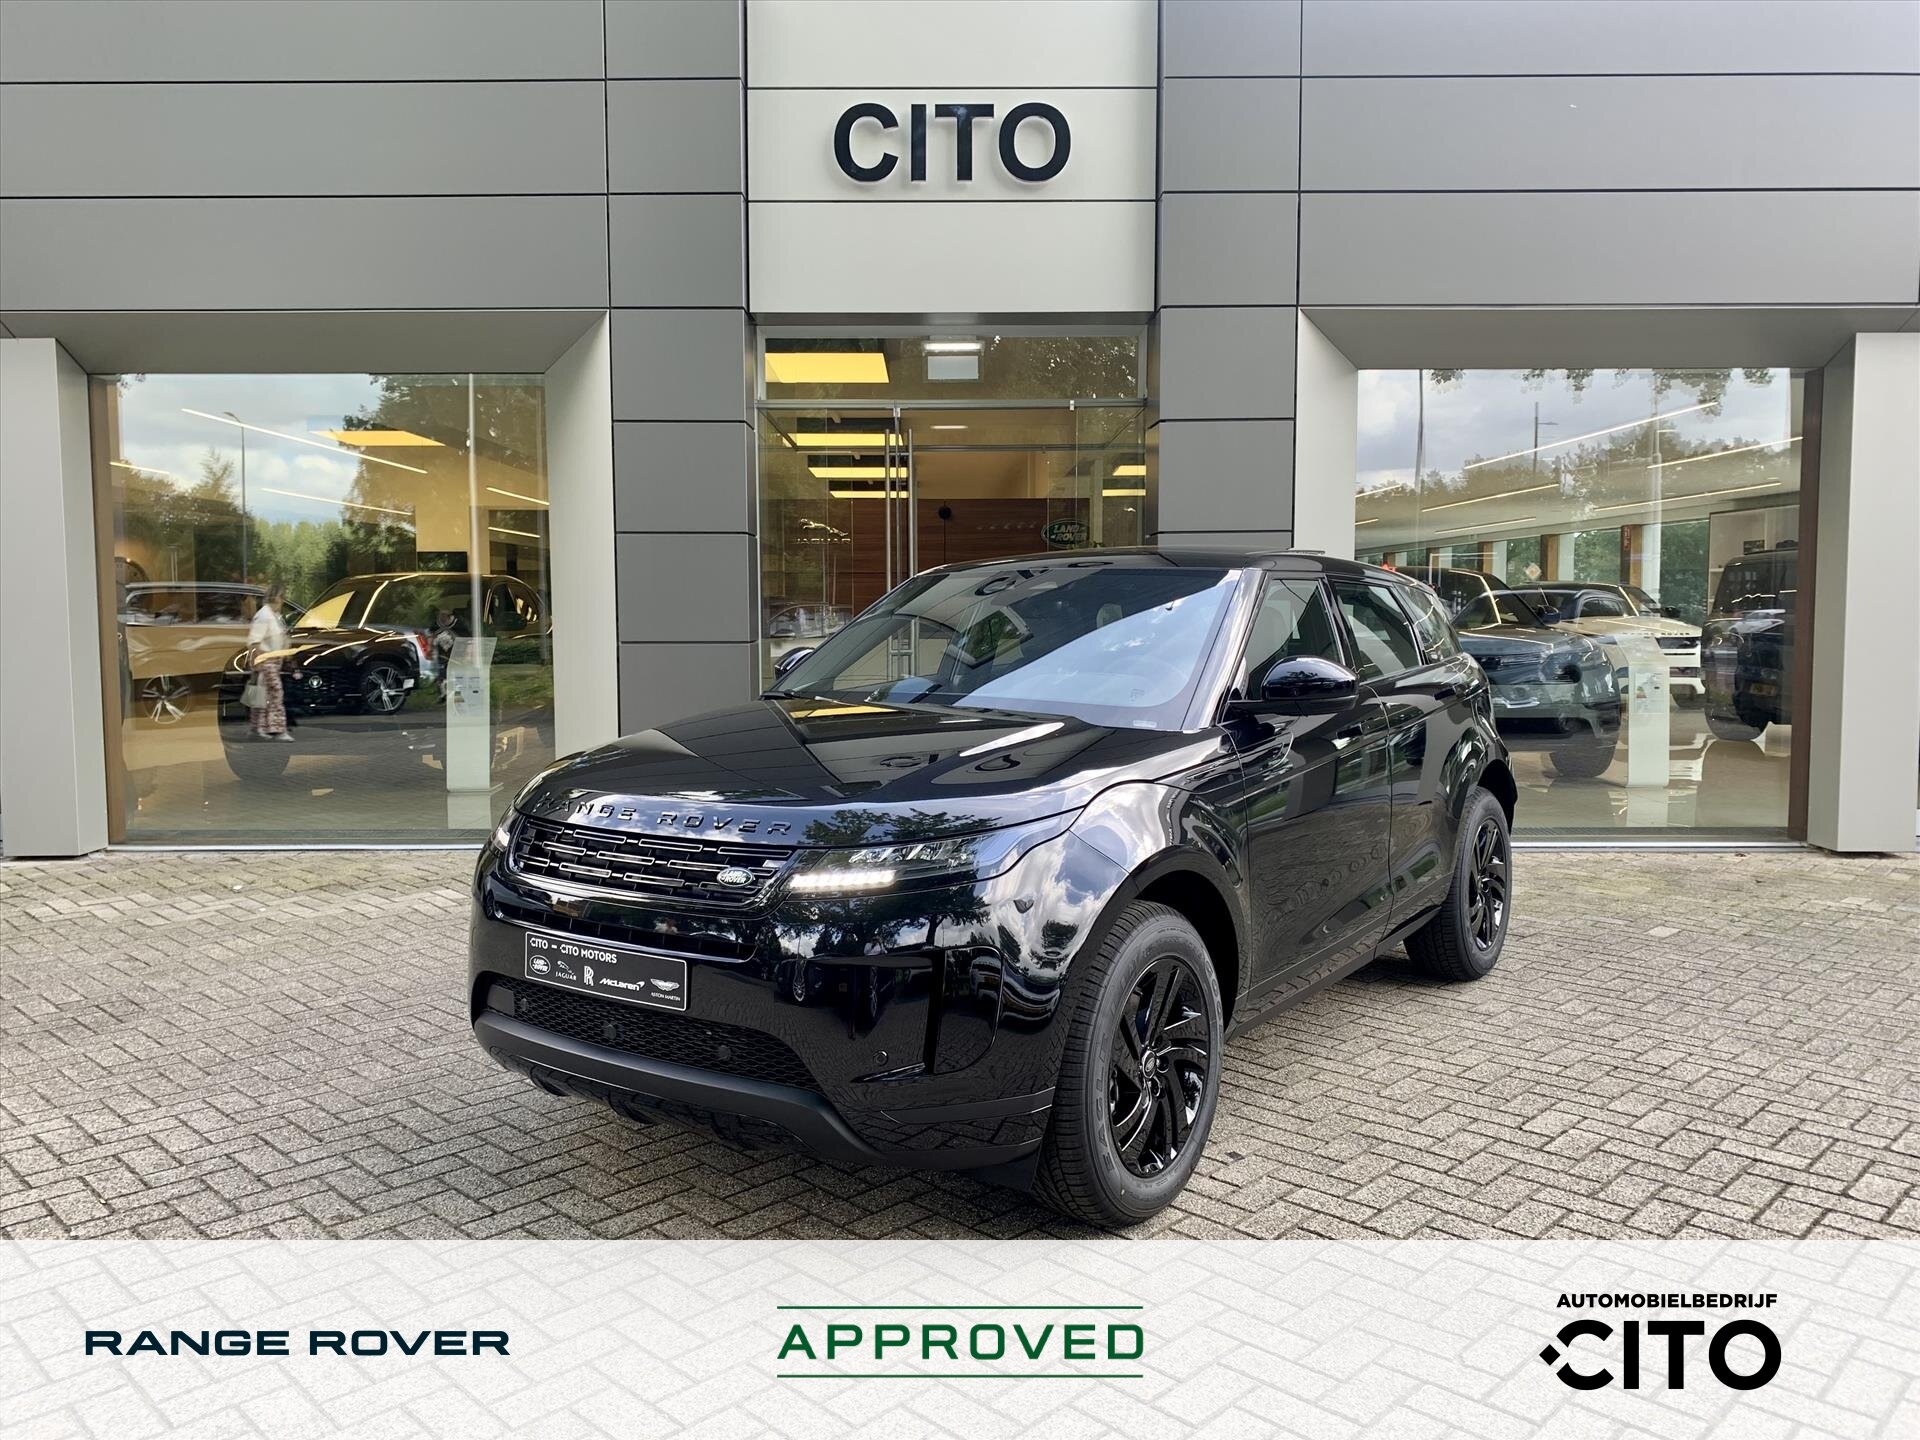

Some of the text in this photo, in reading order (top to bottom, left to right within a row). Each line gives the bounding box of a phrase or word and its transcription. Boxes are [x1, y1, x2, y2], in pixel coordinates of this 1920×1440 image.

[834, 102, 1071, 182] CITO
[1054, 525, 1079, 533] LAND
[1057, 532, 1087, 541] ROVER
[657, 811, 791, 836] ROVER
[725, 870, 746, 879] LAND
[724, 876, 746, 884] ROVER
[530, 937, 548, 949] CITO
[560, 943, 579, 956] CITO
[581, 949, 617, 964] MOTORS
[555, 971, 577, 981] JAGUAR
